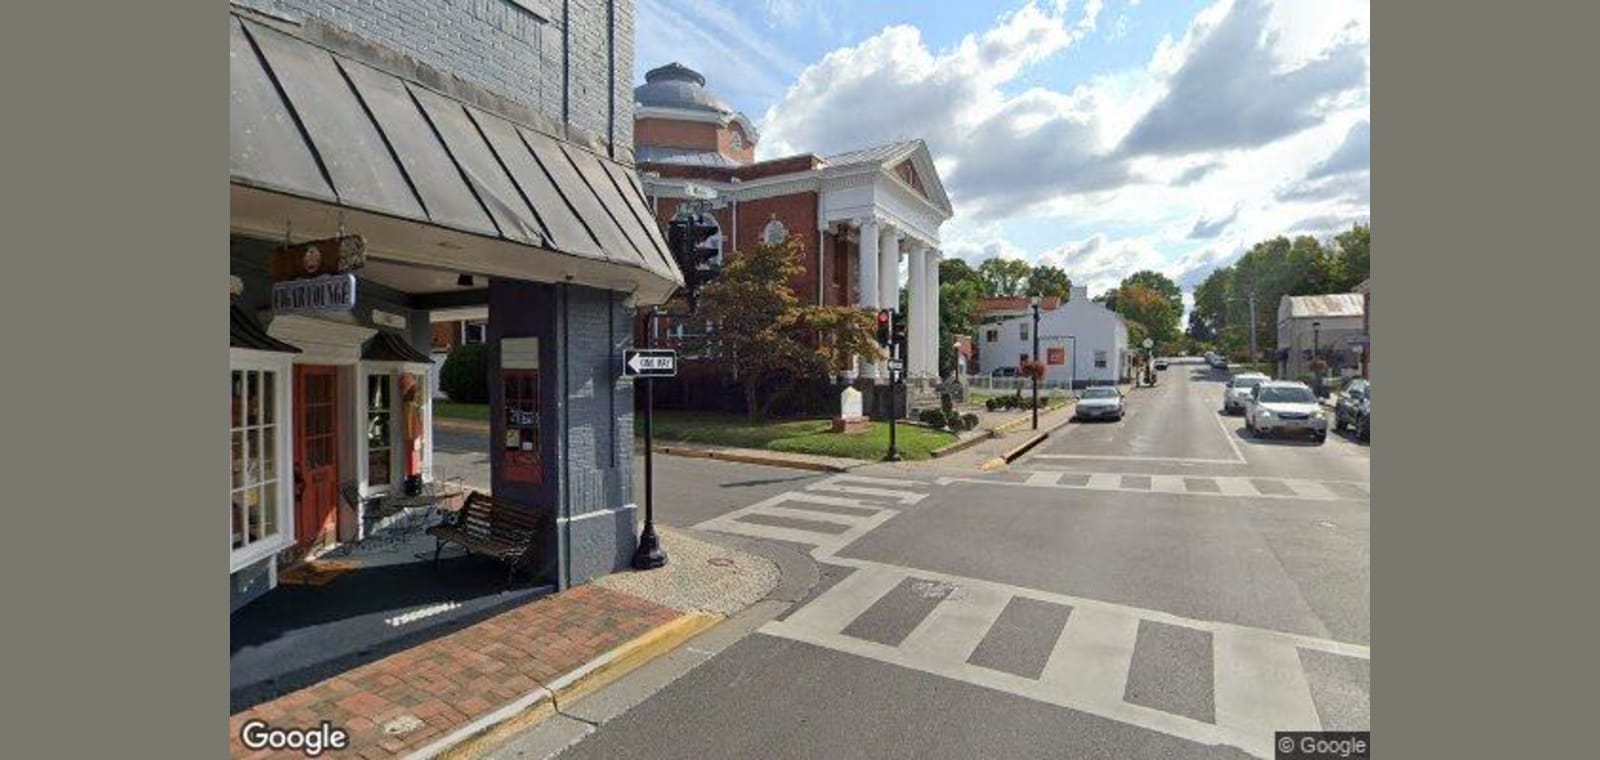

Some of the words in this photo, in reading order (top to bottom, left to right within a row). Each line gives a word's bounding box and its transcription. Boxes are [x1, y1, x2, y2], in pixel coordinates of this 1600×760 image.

[306, 282, 346, 307] LOUNGE
[640, 358, 655, 368] ONE
[656, 358, 671, 368] WAY
